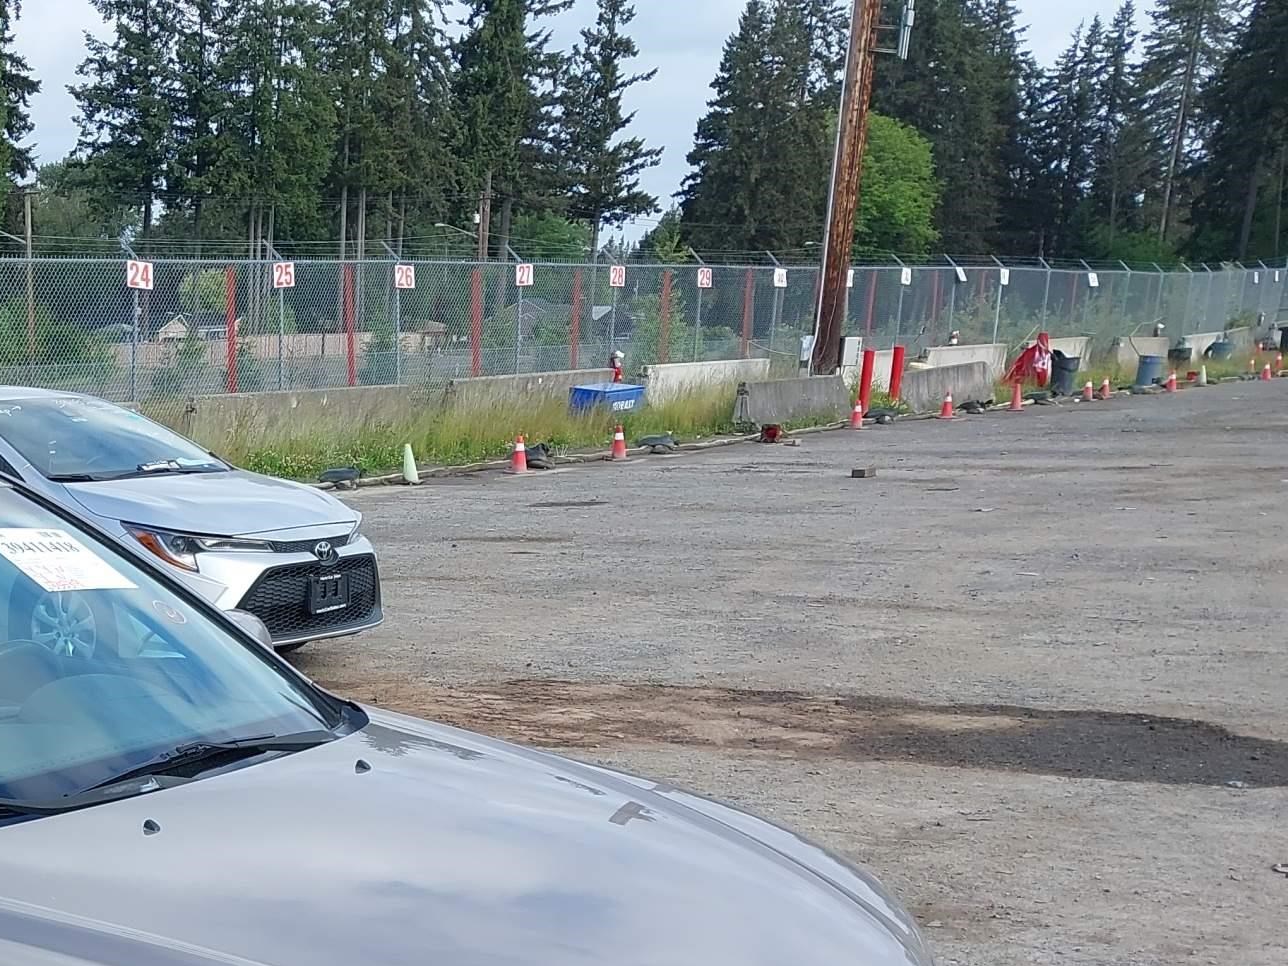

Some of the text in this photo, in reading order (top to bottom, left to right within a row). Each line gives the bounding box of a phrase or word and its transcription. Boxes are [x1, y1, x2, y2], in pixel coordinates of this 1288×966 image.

[129, 262, 150, 288] 24
[275, 264, 292, 286] 25
[397, 266, 412, 286] 26
[518, 265, 530, 285] 27
[611, 267, 623, 285] 28
[699, 269, 711, 286] 29
[0, 541, 80, 554] 39411418
